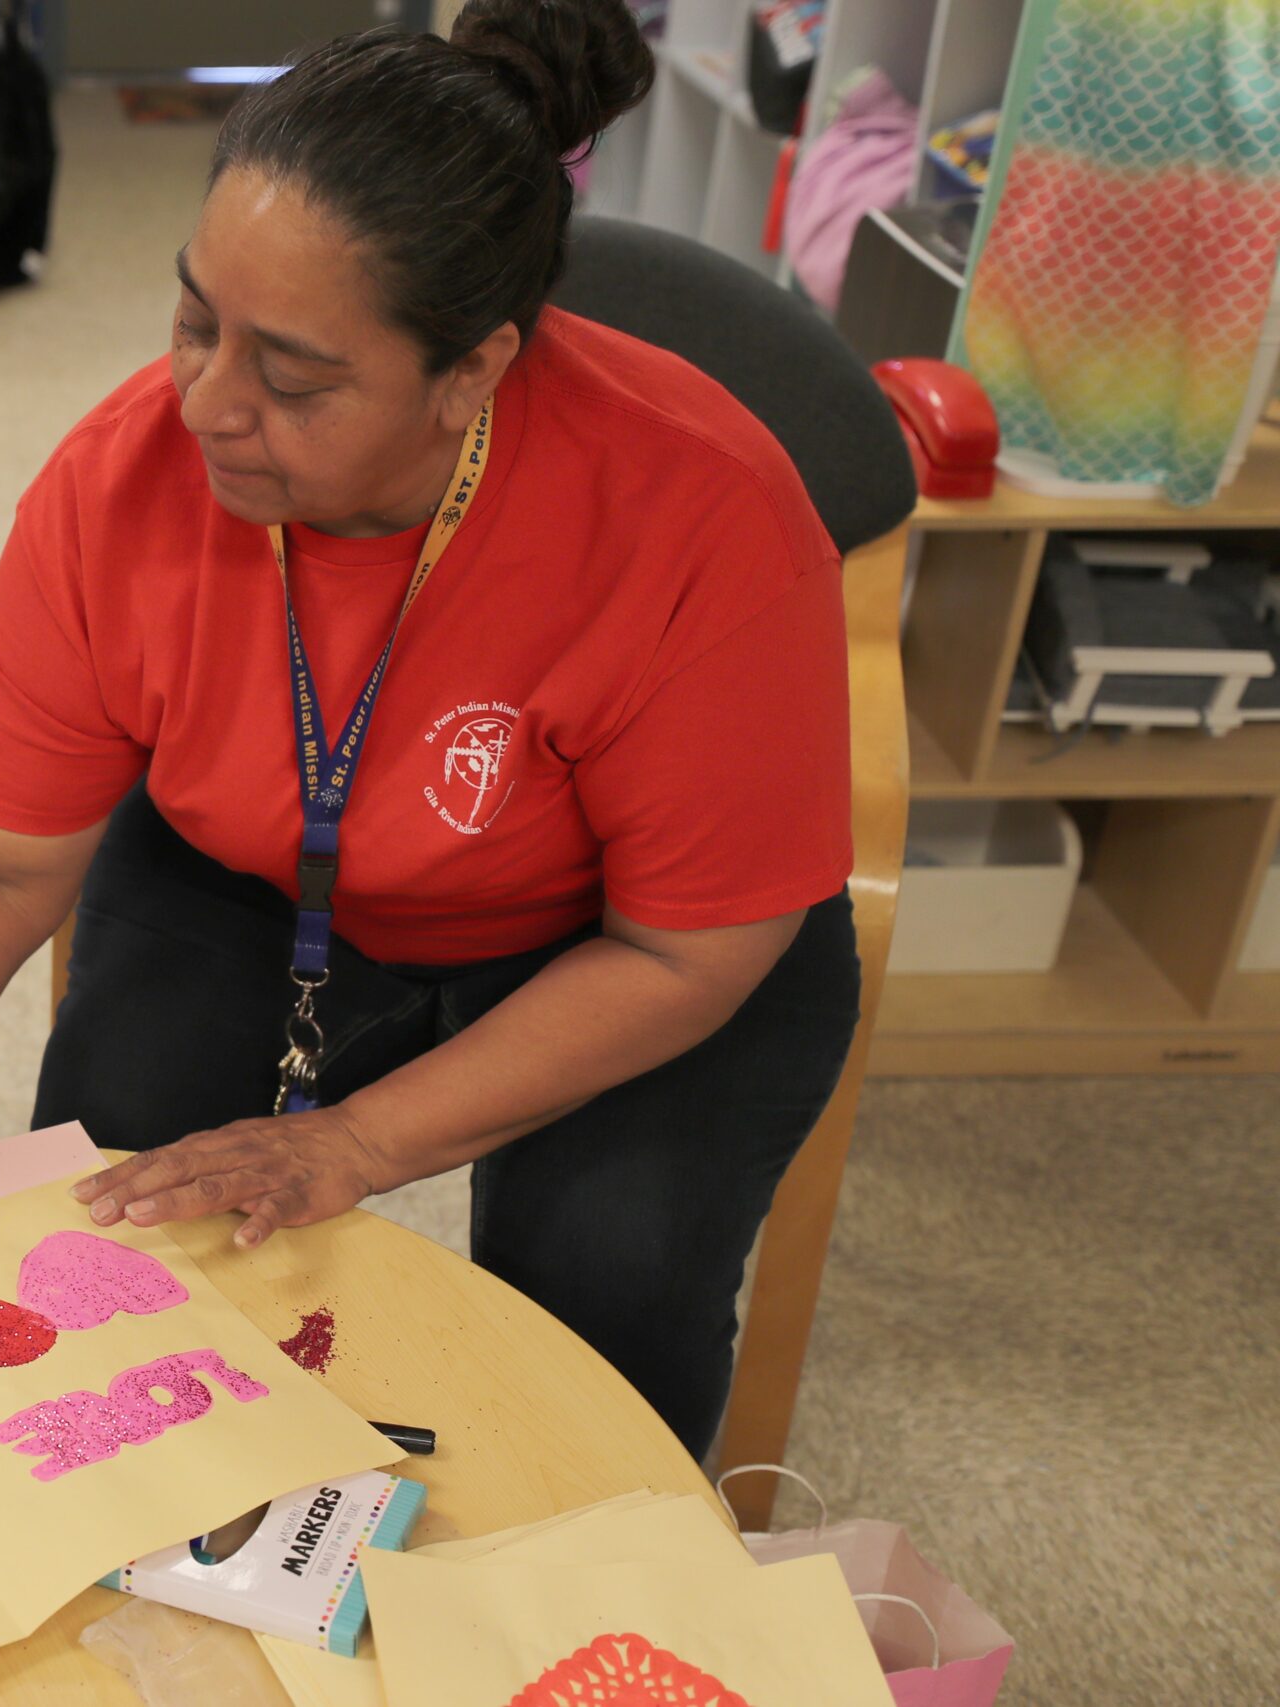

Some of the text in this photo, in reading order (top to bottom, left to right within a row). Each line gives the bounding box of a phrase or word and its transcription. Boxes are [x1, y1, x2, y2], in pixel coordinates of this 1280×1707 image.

[469, 405, 489, 465] Peter
[297, 671, 314, 735] Indian
[424, 700, 521, 744] St. Peter Indian Missi
[331, 763, 350, 788] St.
[341, 706, 367, 758] Peter
[423, 786, 483, 835] Gila River Indian
[276, 1503, 307, 1544] WASHABLE
[281, 1486, 343, 1577] MARKERS
[327, 1540, 343, 1552] TIP
